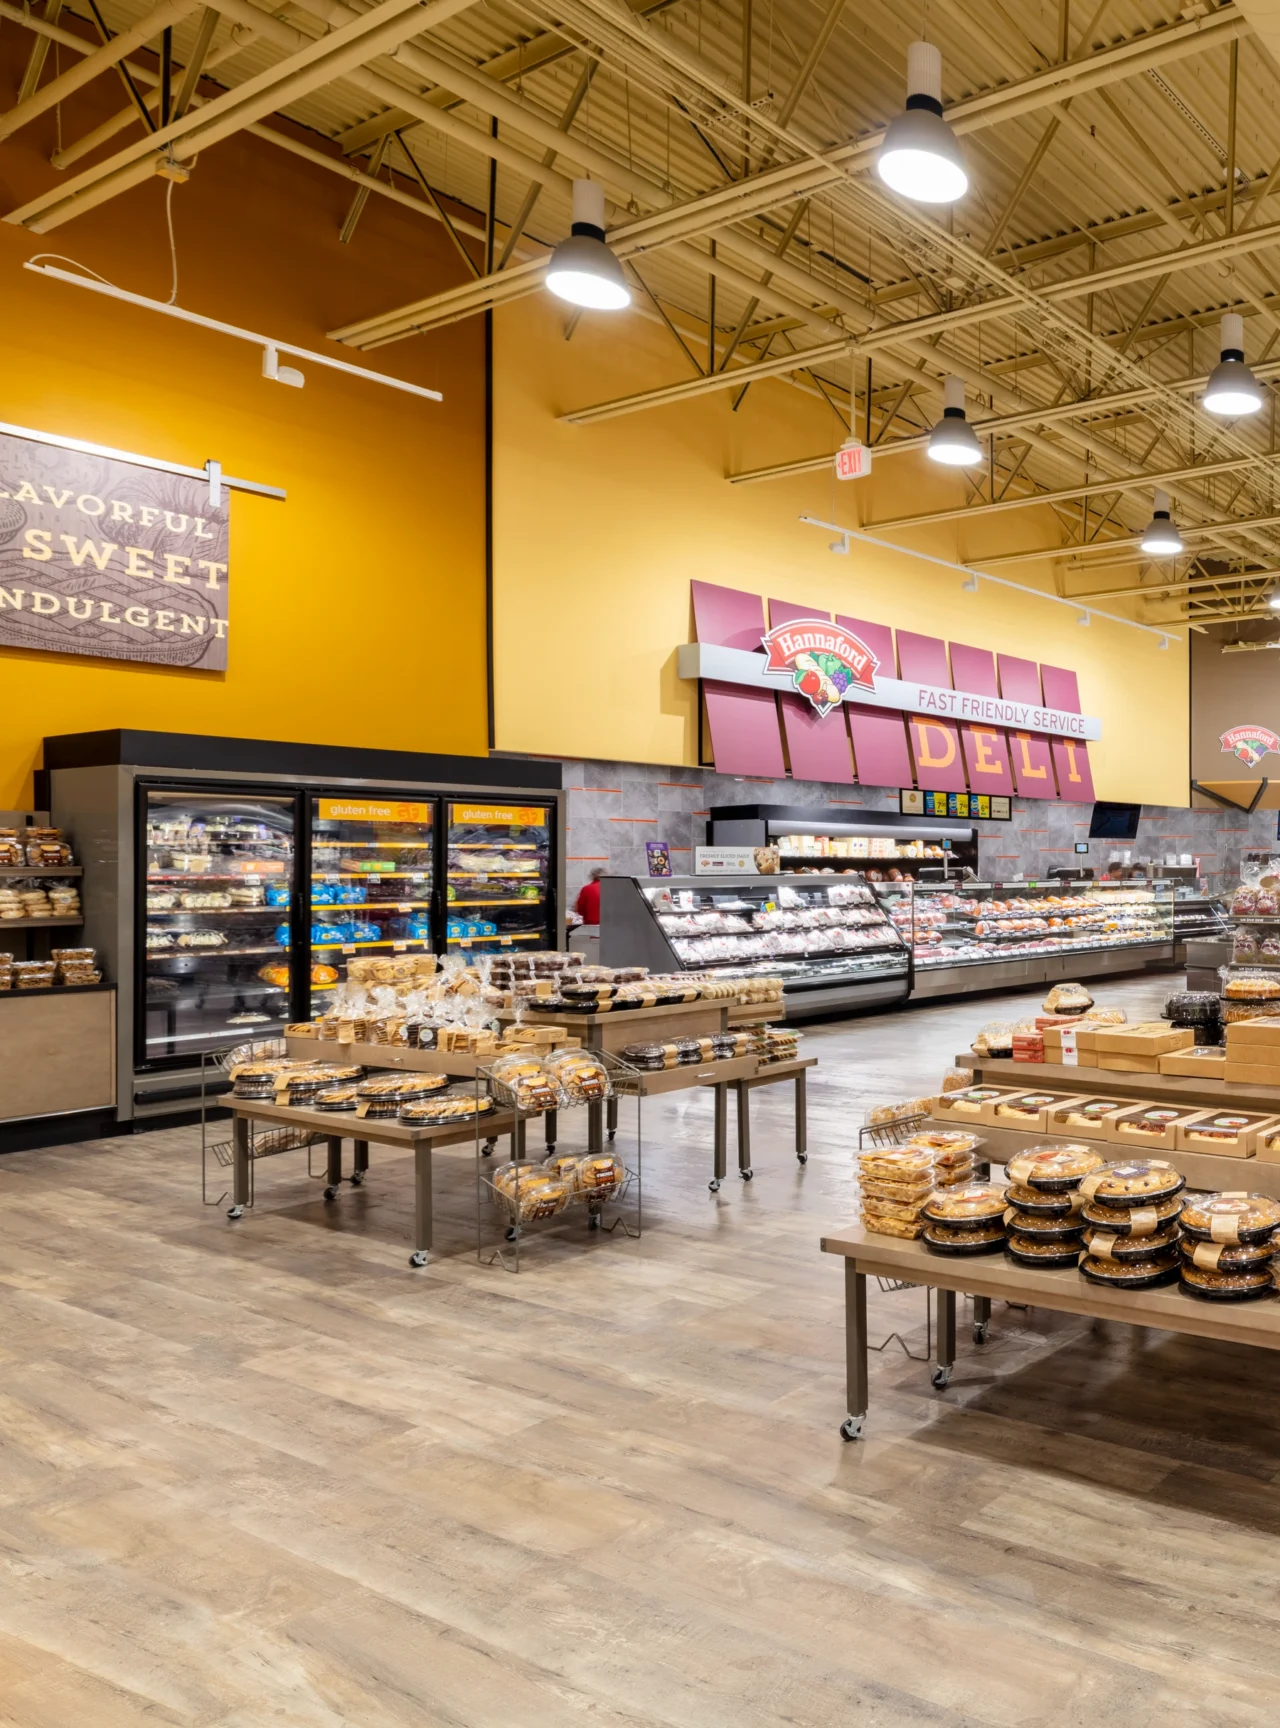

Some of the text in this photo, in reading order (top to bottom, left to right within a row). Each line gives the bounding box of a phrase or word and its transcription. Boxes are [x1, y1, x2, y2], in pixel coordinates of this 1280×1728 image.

[841, 448, 862, 476] EXIT
[23, 529, 228, 590] SWEET
[777, 632, 868, 671] Hannaford
[918, 689, 1085, 734] FAST FRIENDLY SERVICE
[912, 716, 1082, 783] DELI
[1227, 730, 1275, 746] Hannaford
[330, 805, 366, 817] gluten
[369, 805, 391, 816] free
[463, 809, 492, 821] gluten
[494, 809, 513, 820] free
